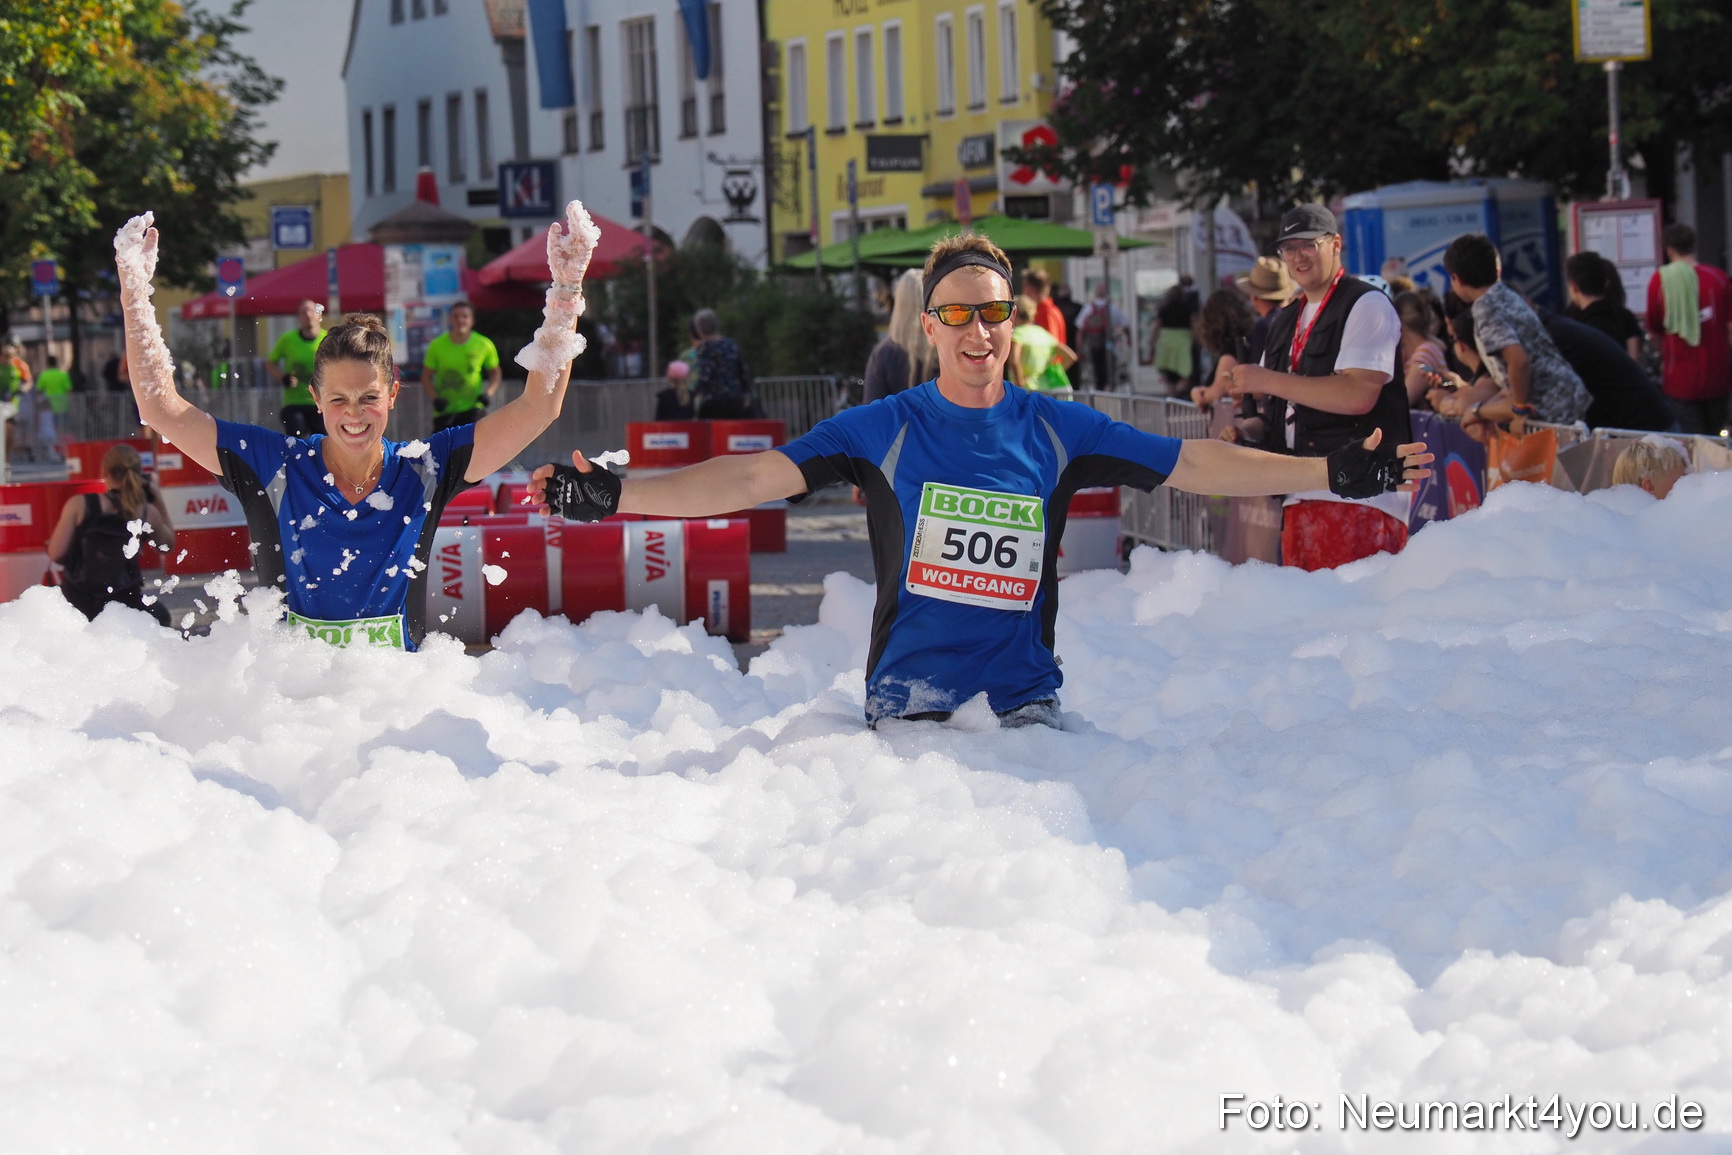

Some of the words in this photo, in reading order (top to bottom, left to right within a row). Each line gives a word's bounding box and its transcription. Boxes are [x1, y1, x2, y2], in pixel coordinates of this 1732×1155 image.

[931, 488, 1038, 527] BOCK
[941, 527, 1020, 569] 506
[922, 567, 1026, 597] WOLFGANG
